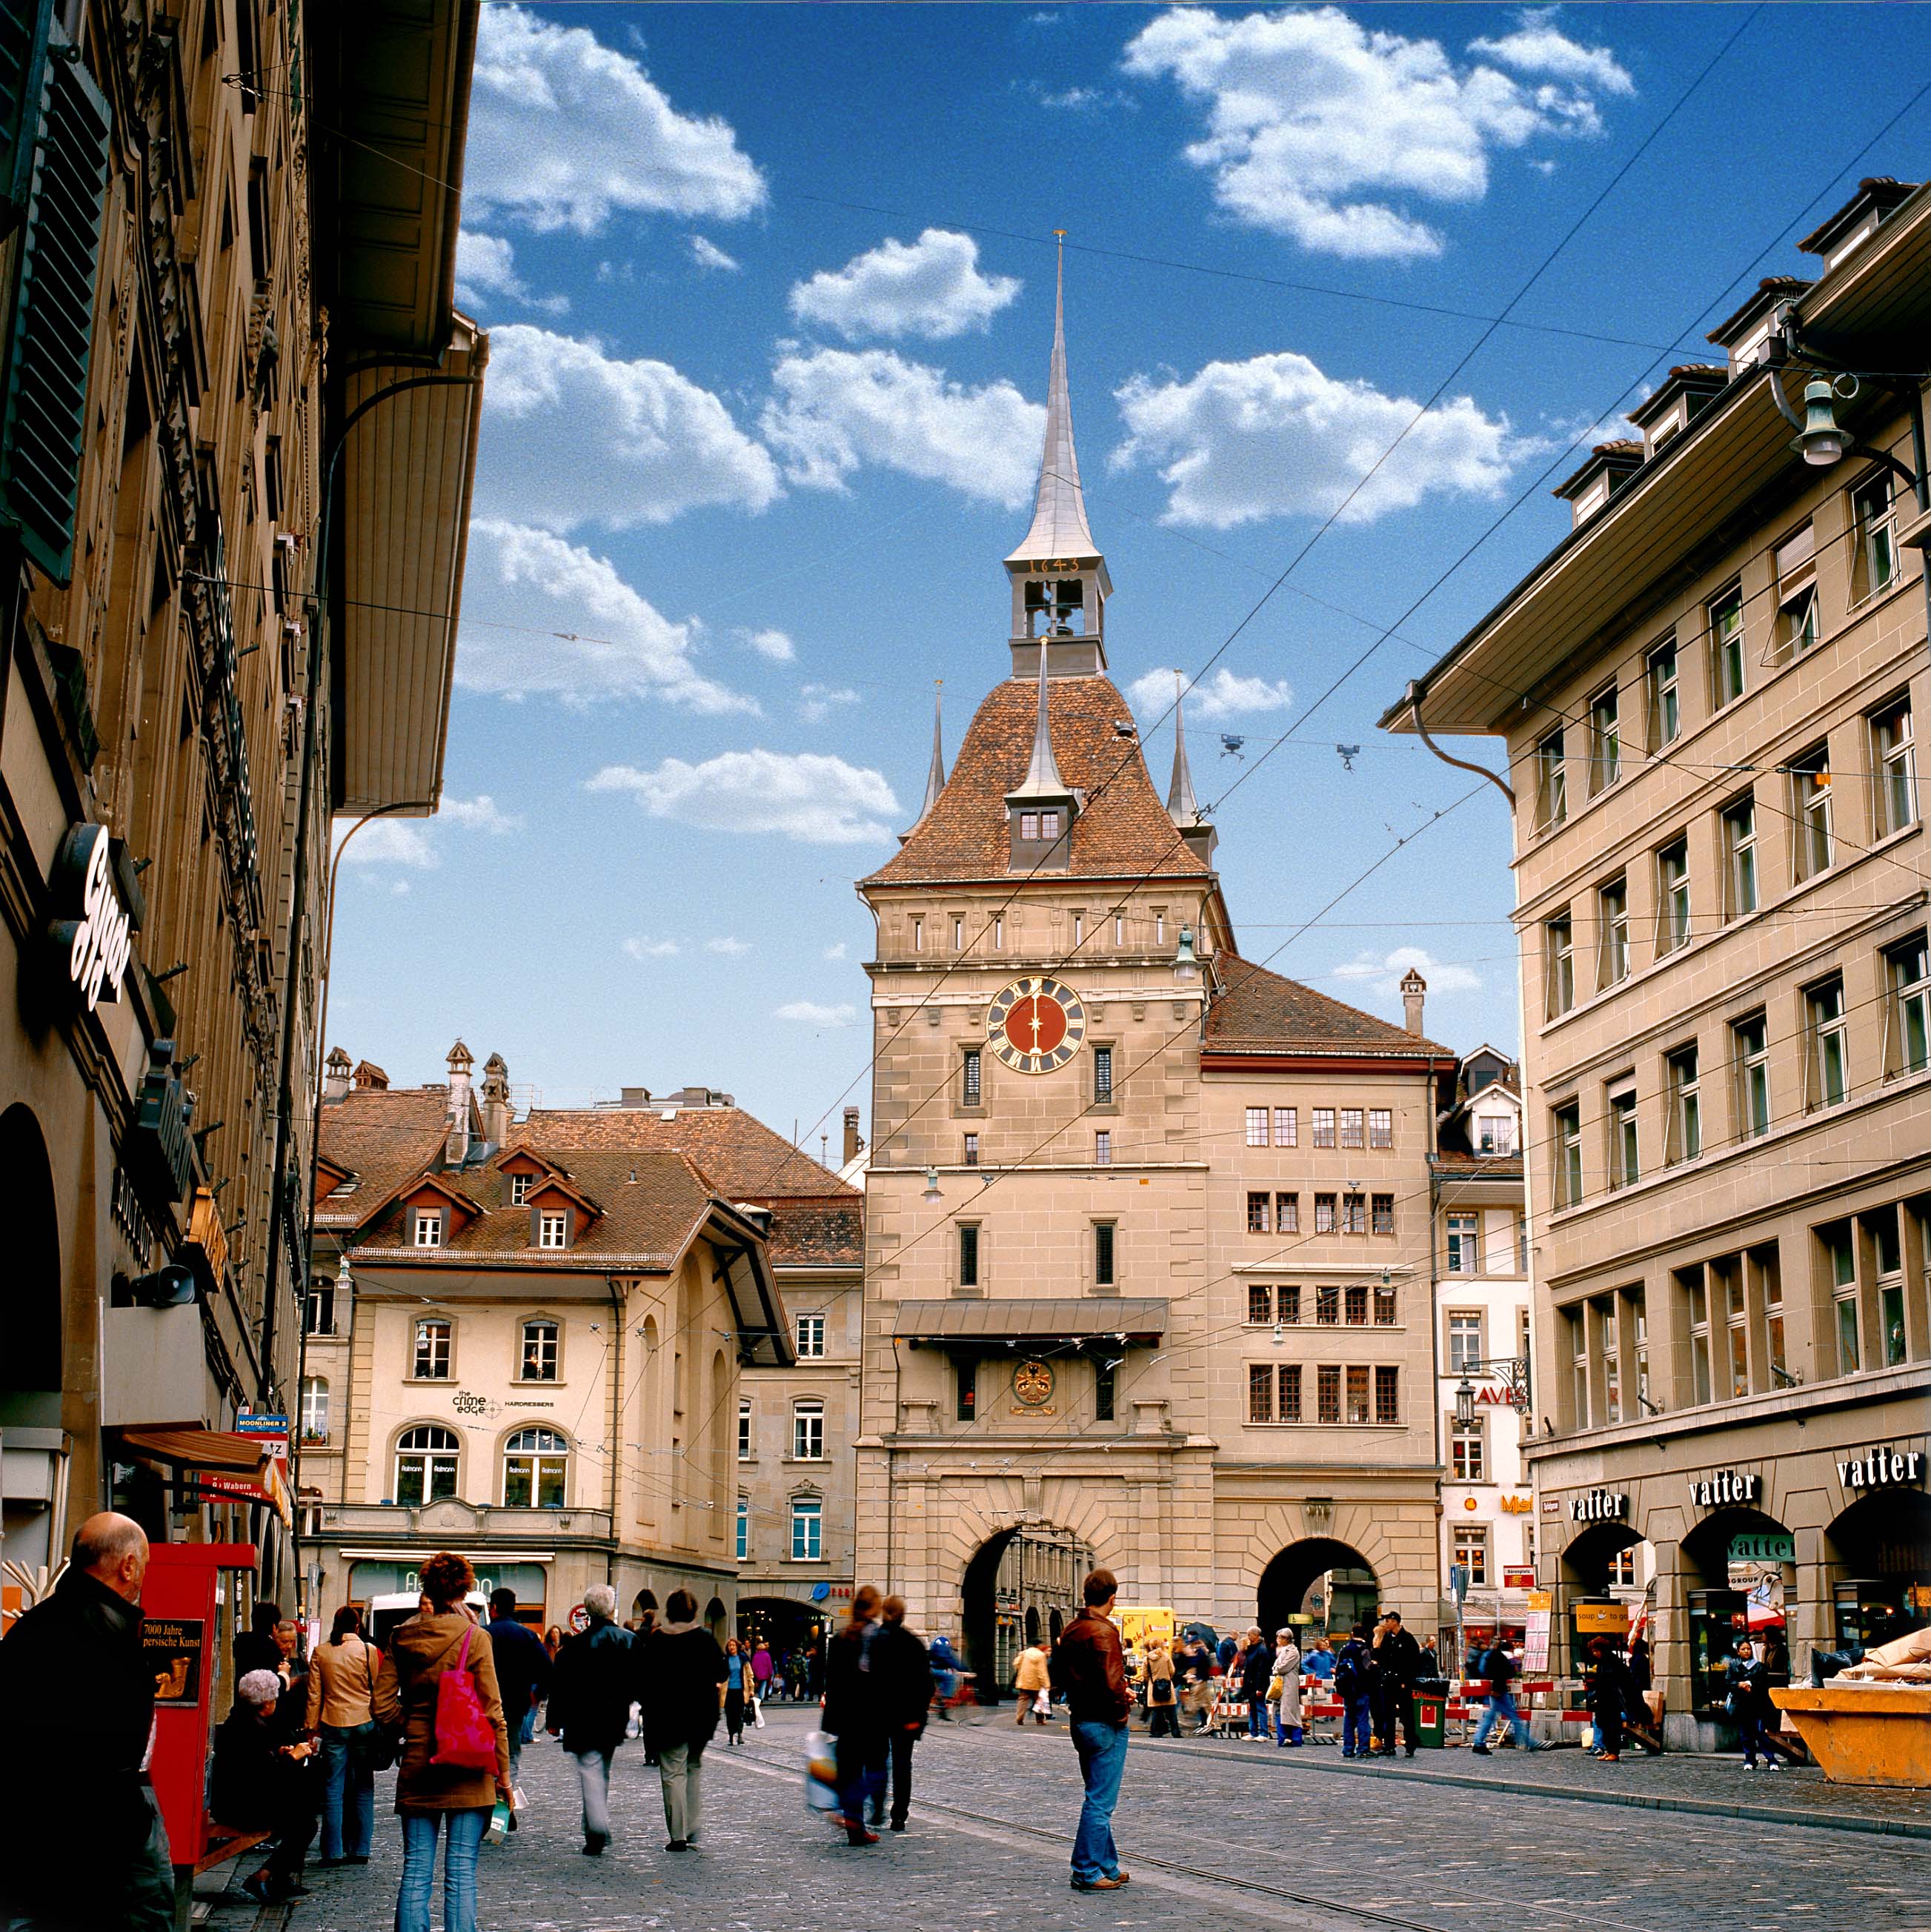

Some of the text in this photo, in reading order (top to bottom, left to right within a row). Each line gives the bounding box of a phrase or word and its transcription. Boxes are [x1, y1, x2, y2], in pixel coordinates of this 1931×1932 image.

[1029, 558, 1080, 573] 1643
[453, 1396, 487, 1406] crime
[456, 1404, 486, 1416] edge
[1837, 1447, 1919, 1487] vatter
[1689, 1470, 1755, 1506] vatter
[1568, 1487, 1622, 1521] vatter
[144, 1624, 183, 1636] 7000 Jahre
[143, 1636, 201, 1647] persische Kunst
